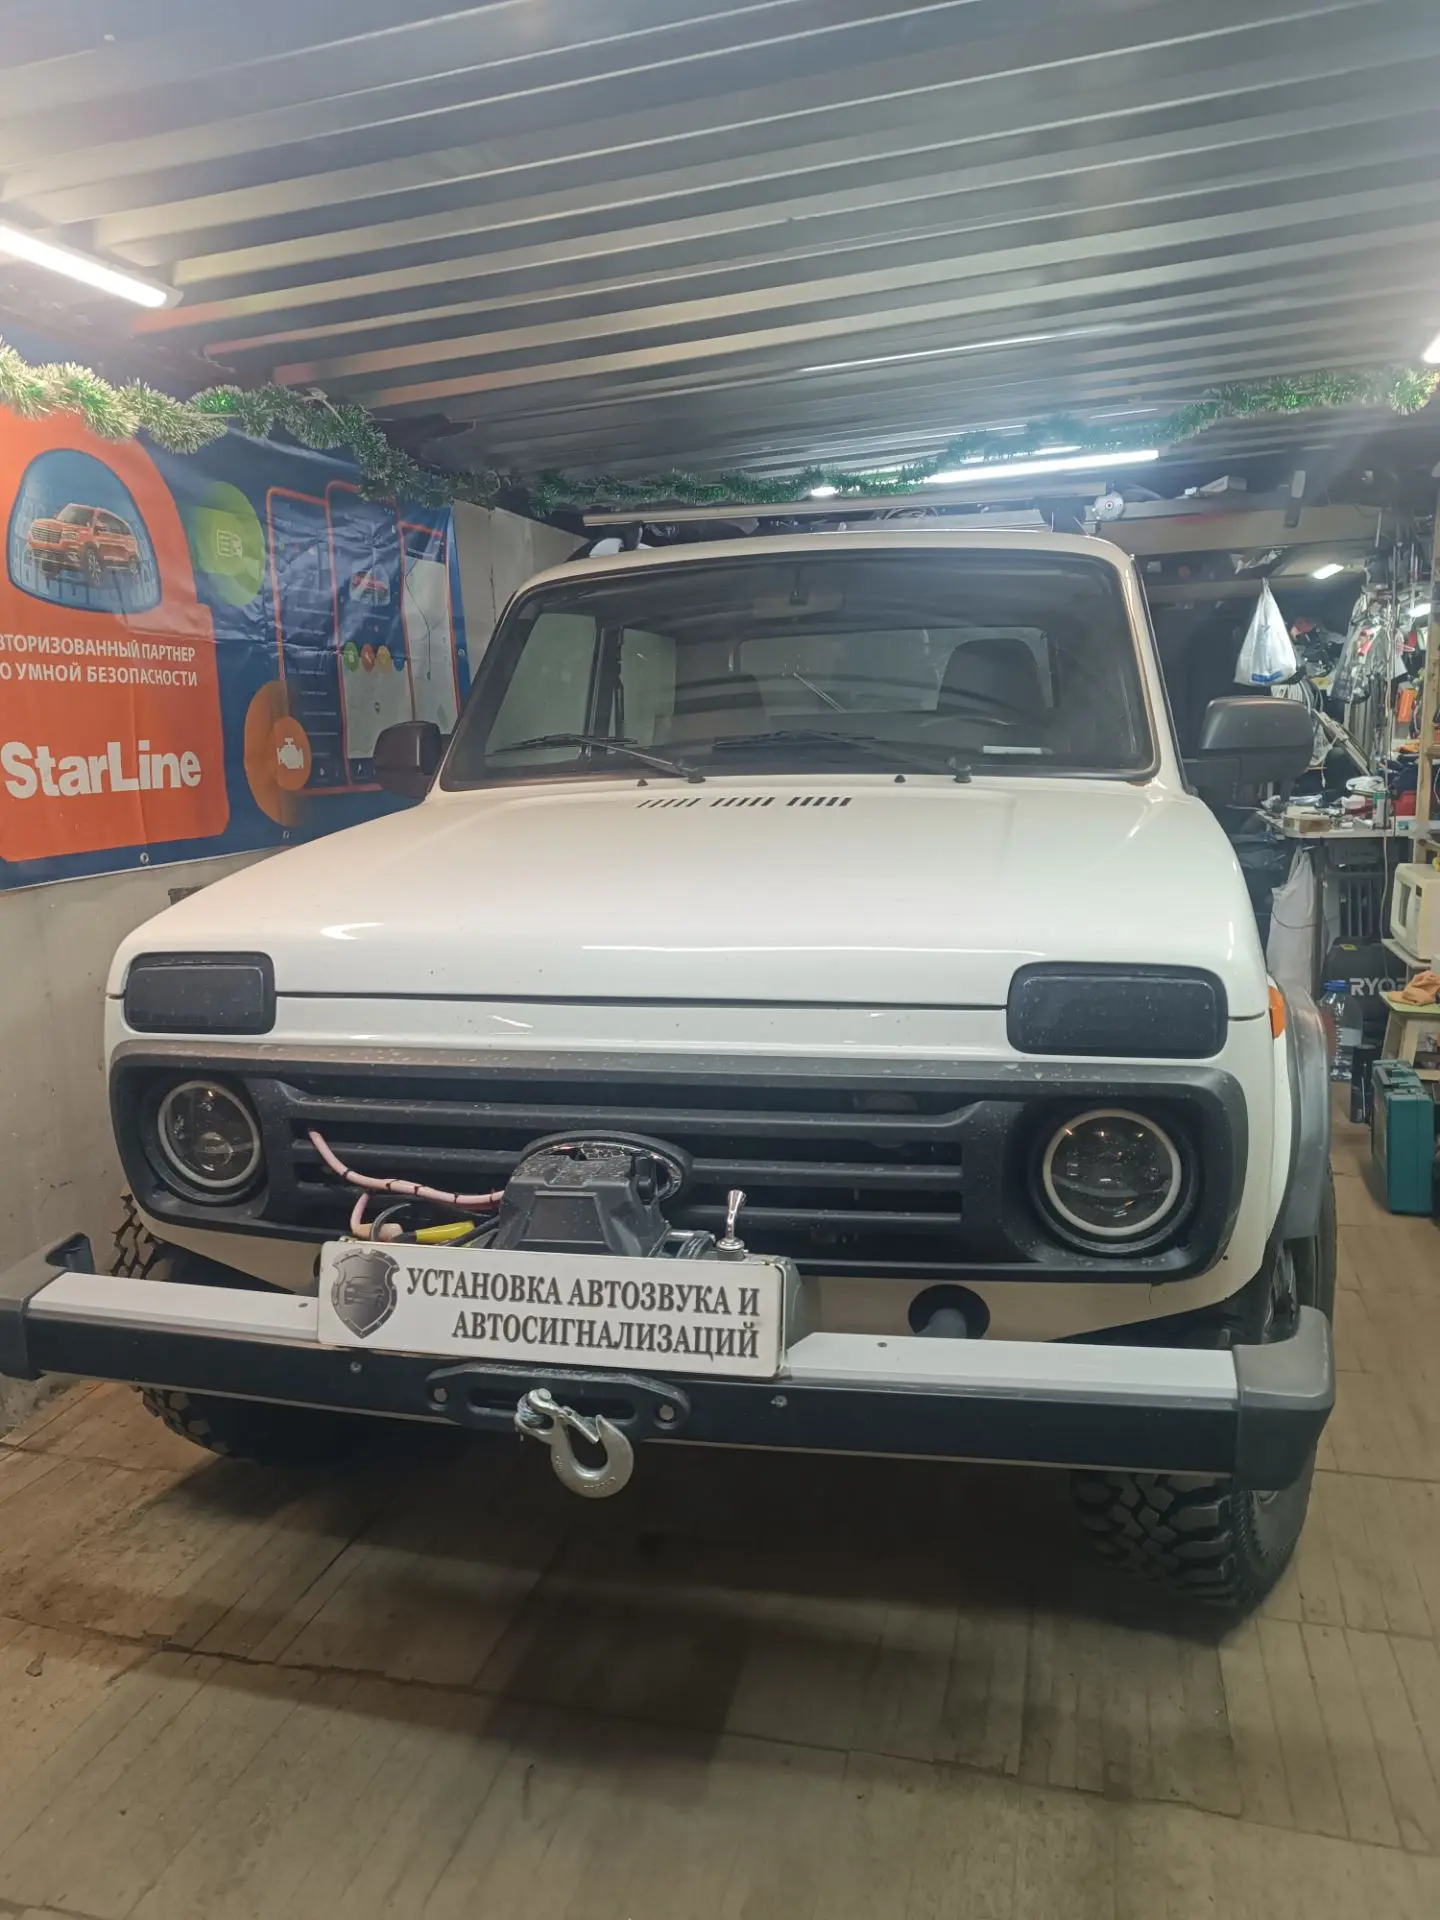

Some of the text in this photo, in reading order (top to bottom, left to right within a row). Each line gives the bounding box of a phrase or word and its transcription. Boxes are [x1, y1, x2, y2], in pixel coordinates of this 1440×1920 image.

[15, 660, 82, 682] УМНОЙ
[87, 665, 198, 686] БЕЗОПАСНОСТИ
[141, 643, 195, 662] ПАРТНЕР
[0, 739, 201, 799] StarLine
[406, 1267, 760, 1317] УСТАНОВКА АВТОЗВУКА И
[452, 1310, 760, 1362] АВТОСИГНАЛИЗАЦИЙ
